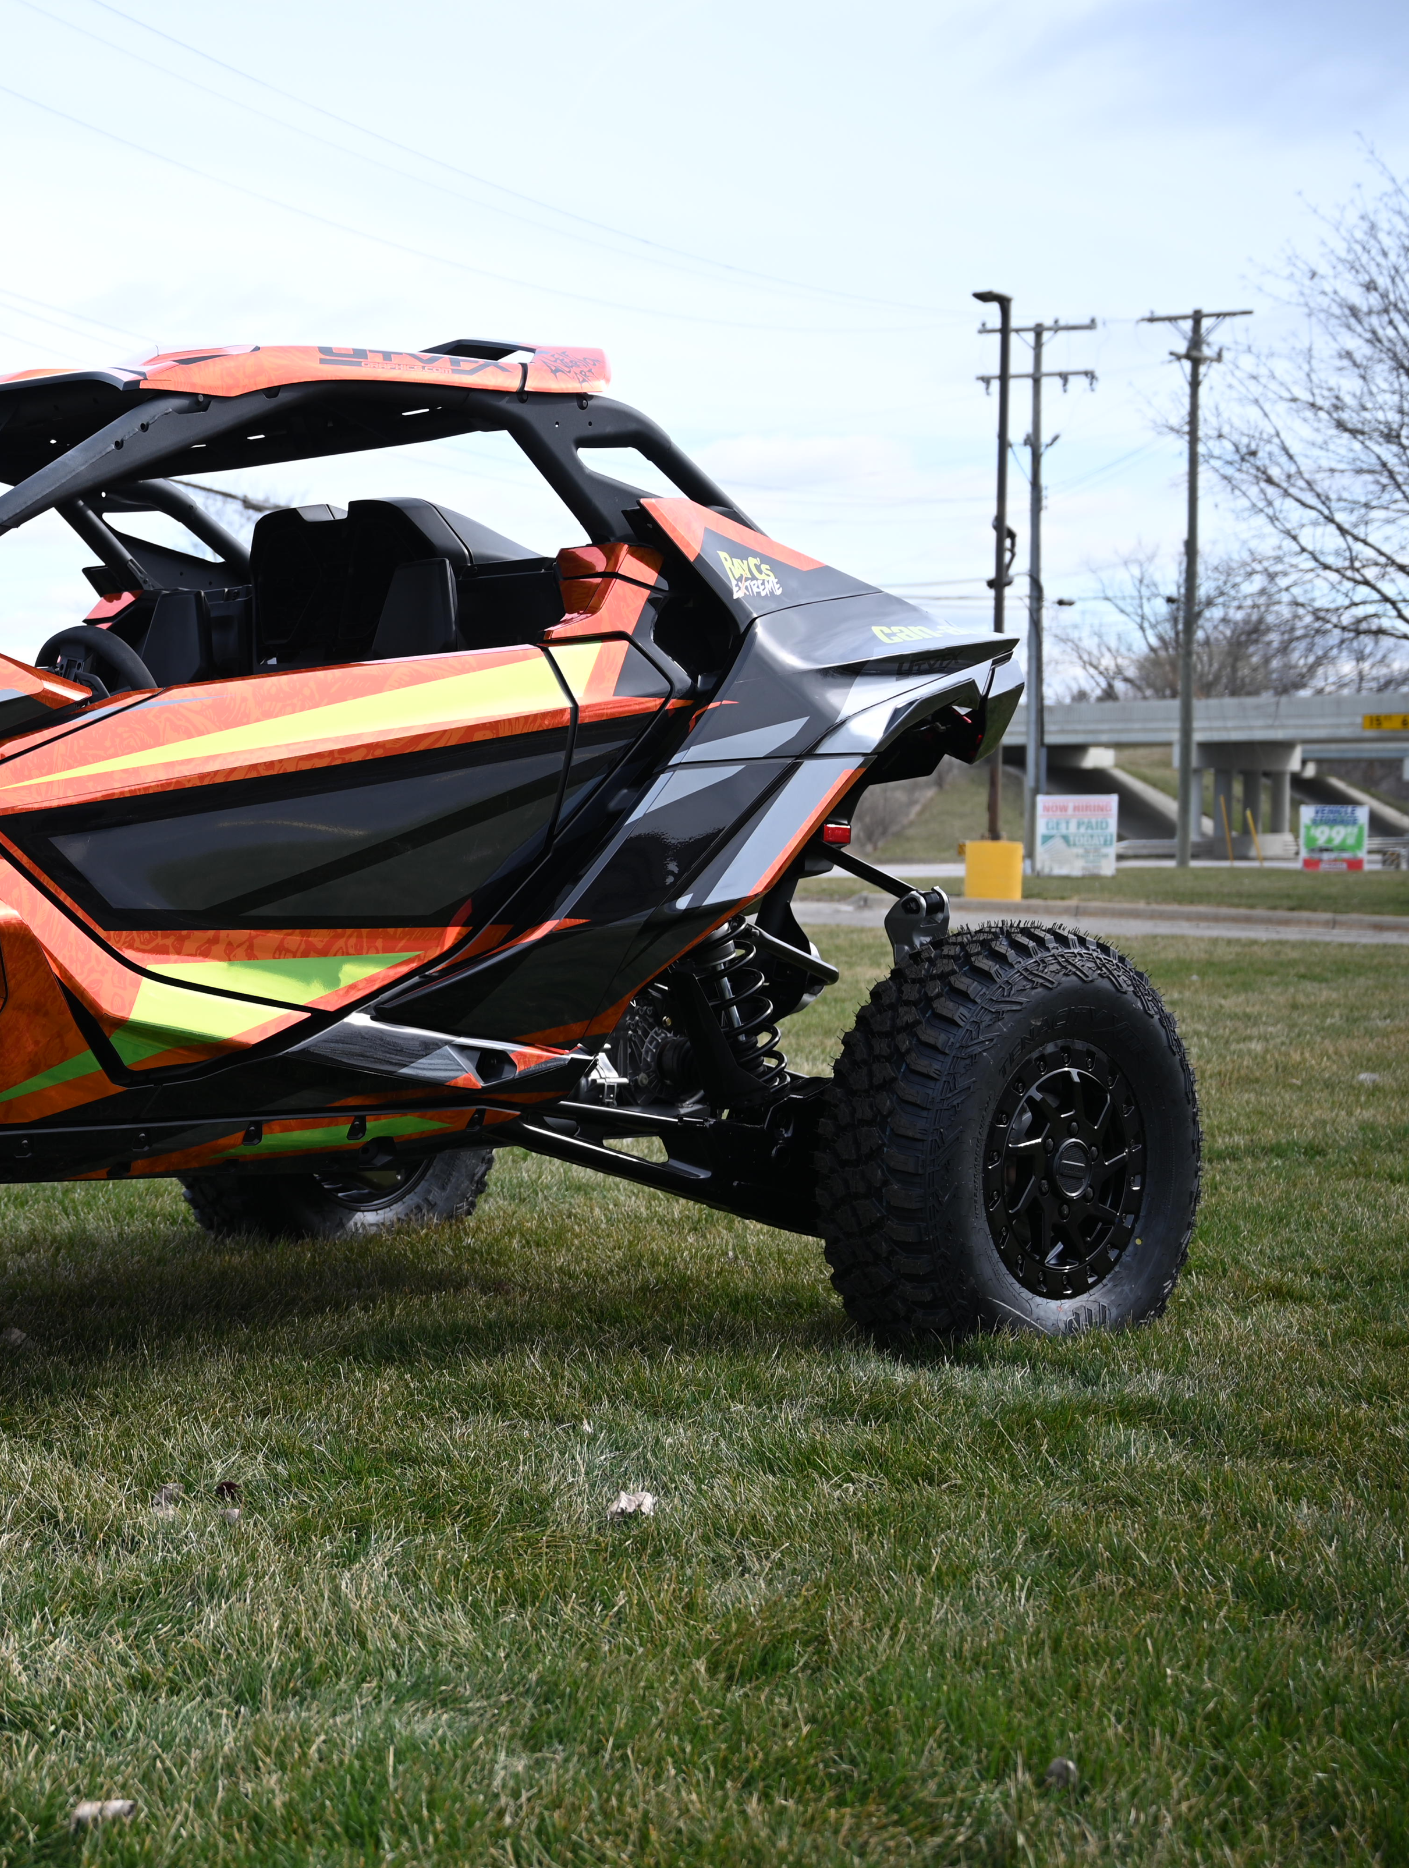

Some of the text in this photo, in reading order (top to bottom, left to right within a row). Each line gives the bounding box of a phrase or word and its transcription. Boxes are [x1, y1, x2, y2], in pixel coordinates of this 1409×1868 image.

[731, 578, 783, 600] EXTREME
[1042, 802, 1112, 813] NOW HIRING
[1314, 805, 1358, 815] VEHICLE
[1045, 819, 1109, 831] GET PAID
[998, 1005, 1108, 1078] TENACITY
